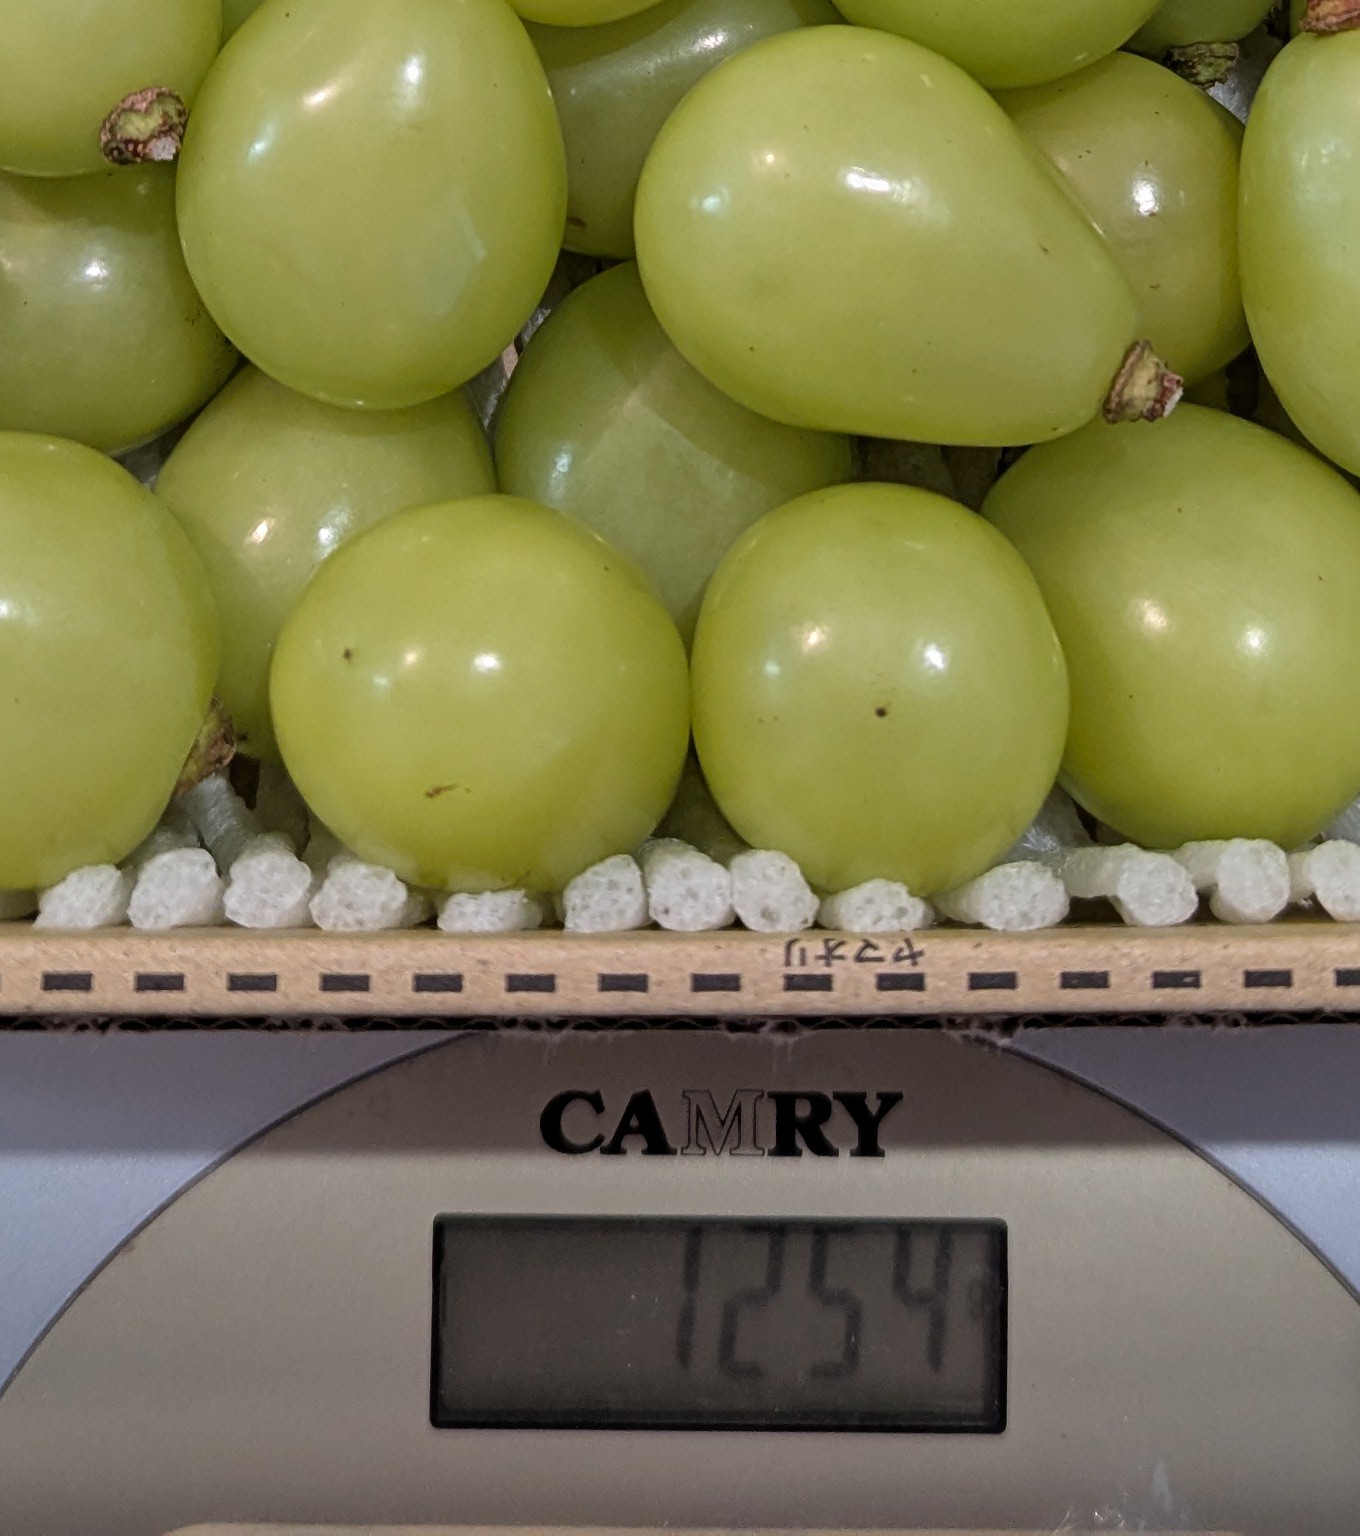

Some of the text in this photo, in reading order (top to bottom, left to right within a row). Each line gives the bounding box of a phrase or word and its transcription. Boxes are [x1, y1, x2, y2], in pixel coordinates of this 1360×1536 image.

[783, 937, 925, 968] ヤマオリ
[540, 1088, 904, 1158] CAMRY
[675, 1223, 953, 1378] 1254
